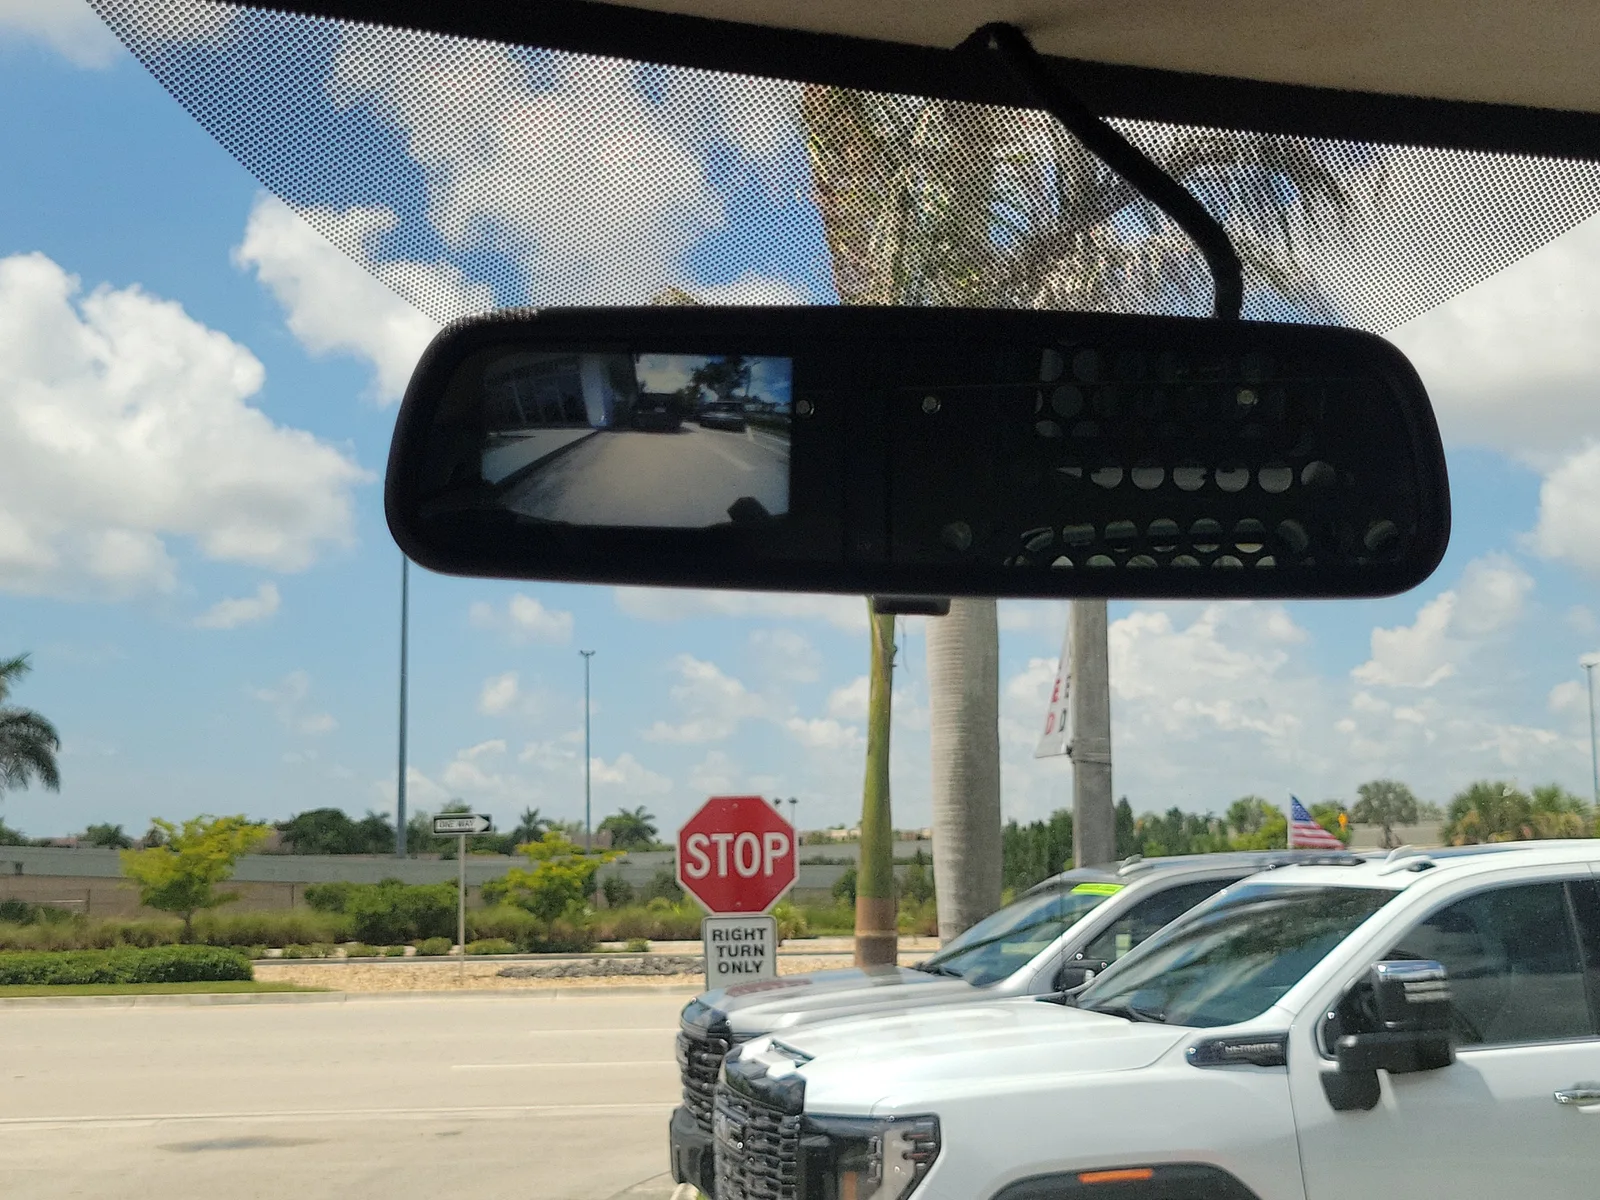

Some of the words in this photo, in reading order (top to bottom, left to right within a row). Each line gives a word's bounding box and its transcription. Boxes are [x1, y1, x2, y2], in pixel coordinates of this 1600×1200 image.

[685, 832, 789, 878] STOP
[712, 928, 767, 942] RIGHT
[716, 944, 765, 958] TURN
[718, 961, 764, 974] ONLY
